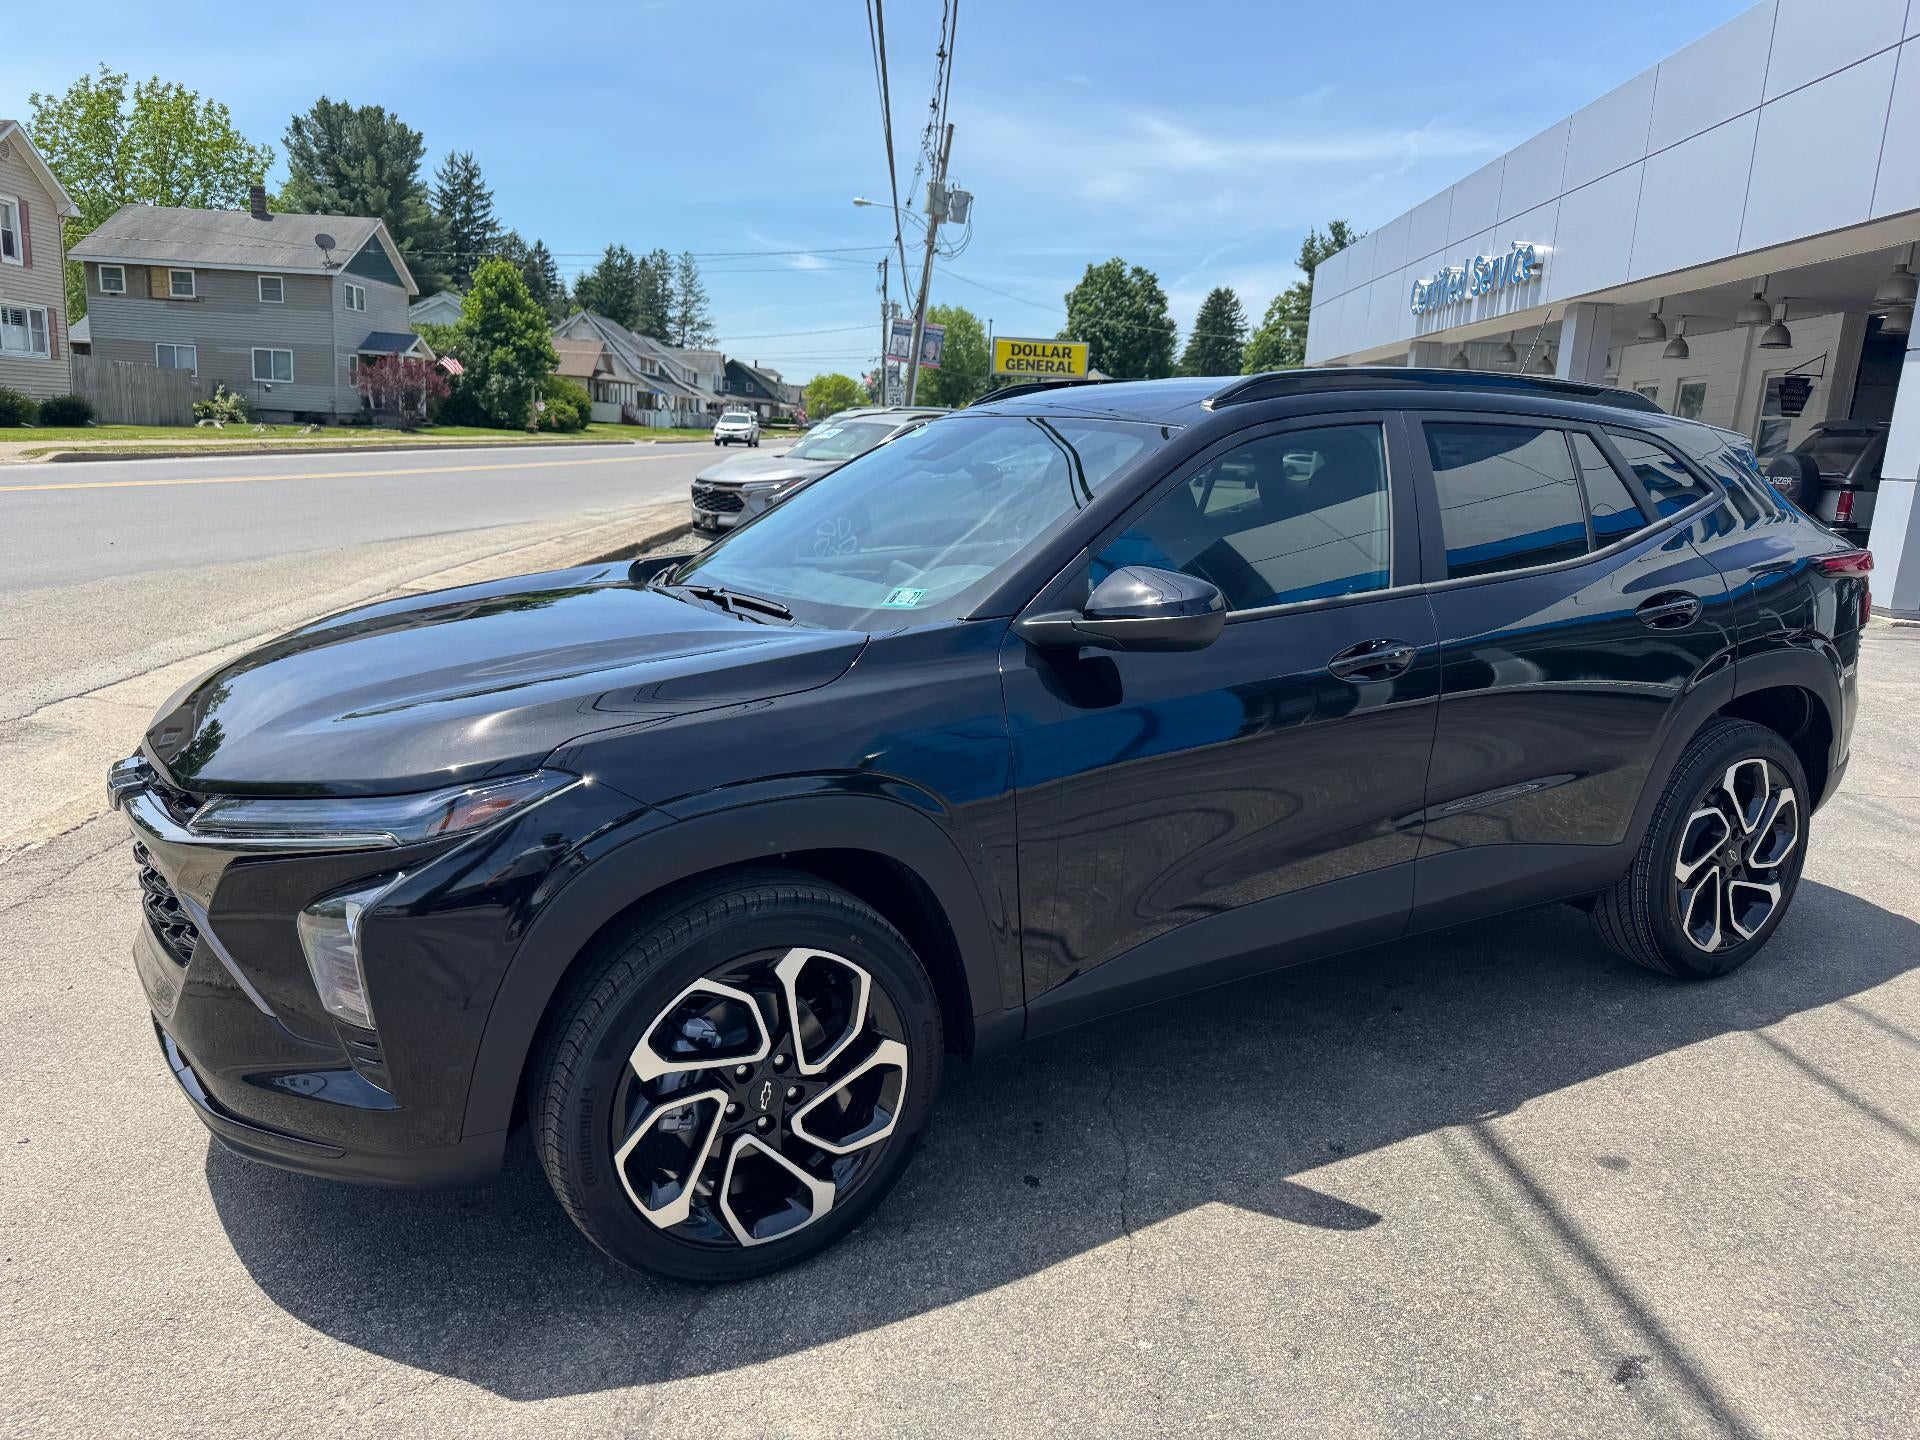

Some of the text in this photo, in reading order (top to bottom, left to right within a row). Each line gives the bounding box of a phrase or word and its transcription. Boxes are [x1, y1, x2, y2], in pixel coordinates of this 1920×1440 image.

[1410, 241, 1536, 315] Certified Service
[1011, 343, 1073, 359] DOLLAR
[1005, 358, 1075, 374] GENERAL
[888, 397, 902, 406] 35
[577, 1097, 599, 1186] Continental
